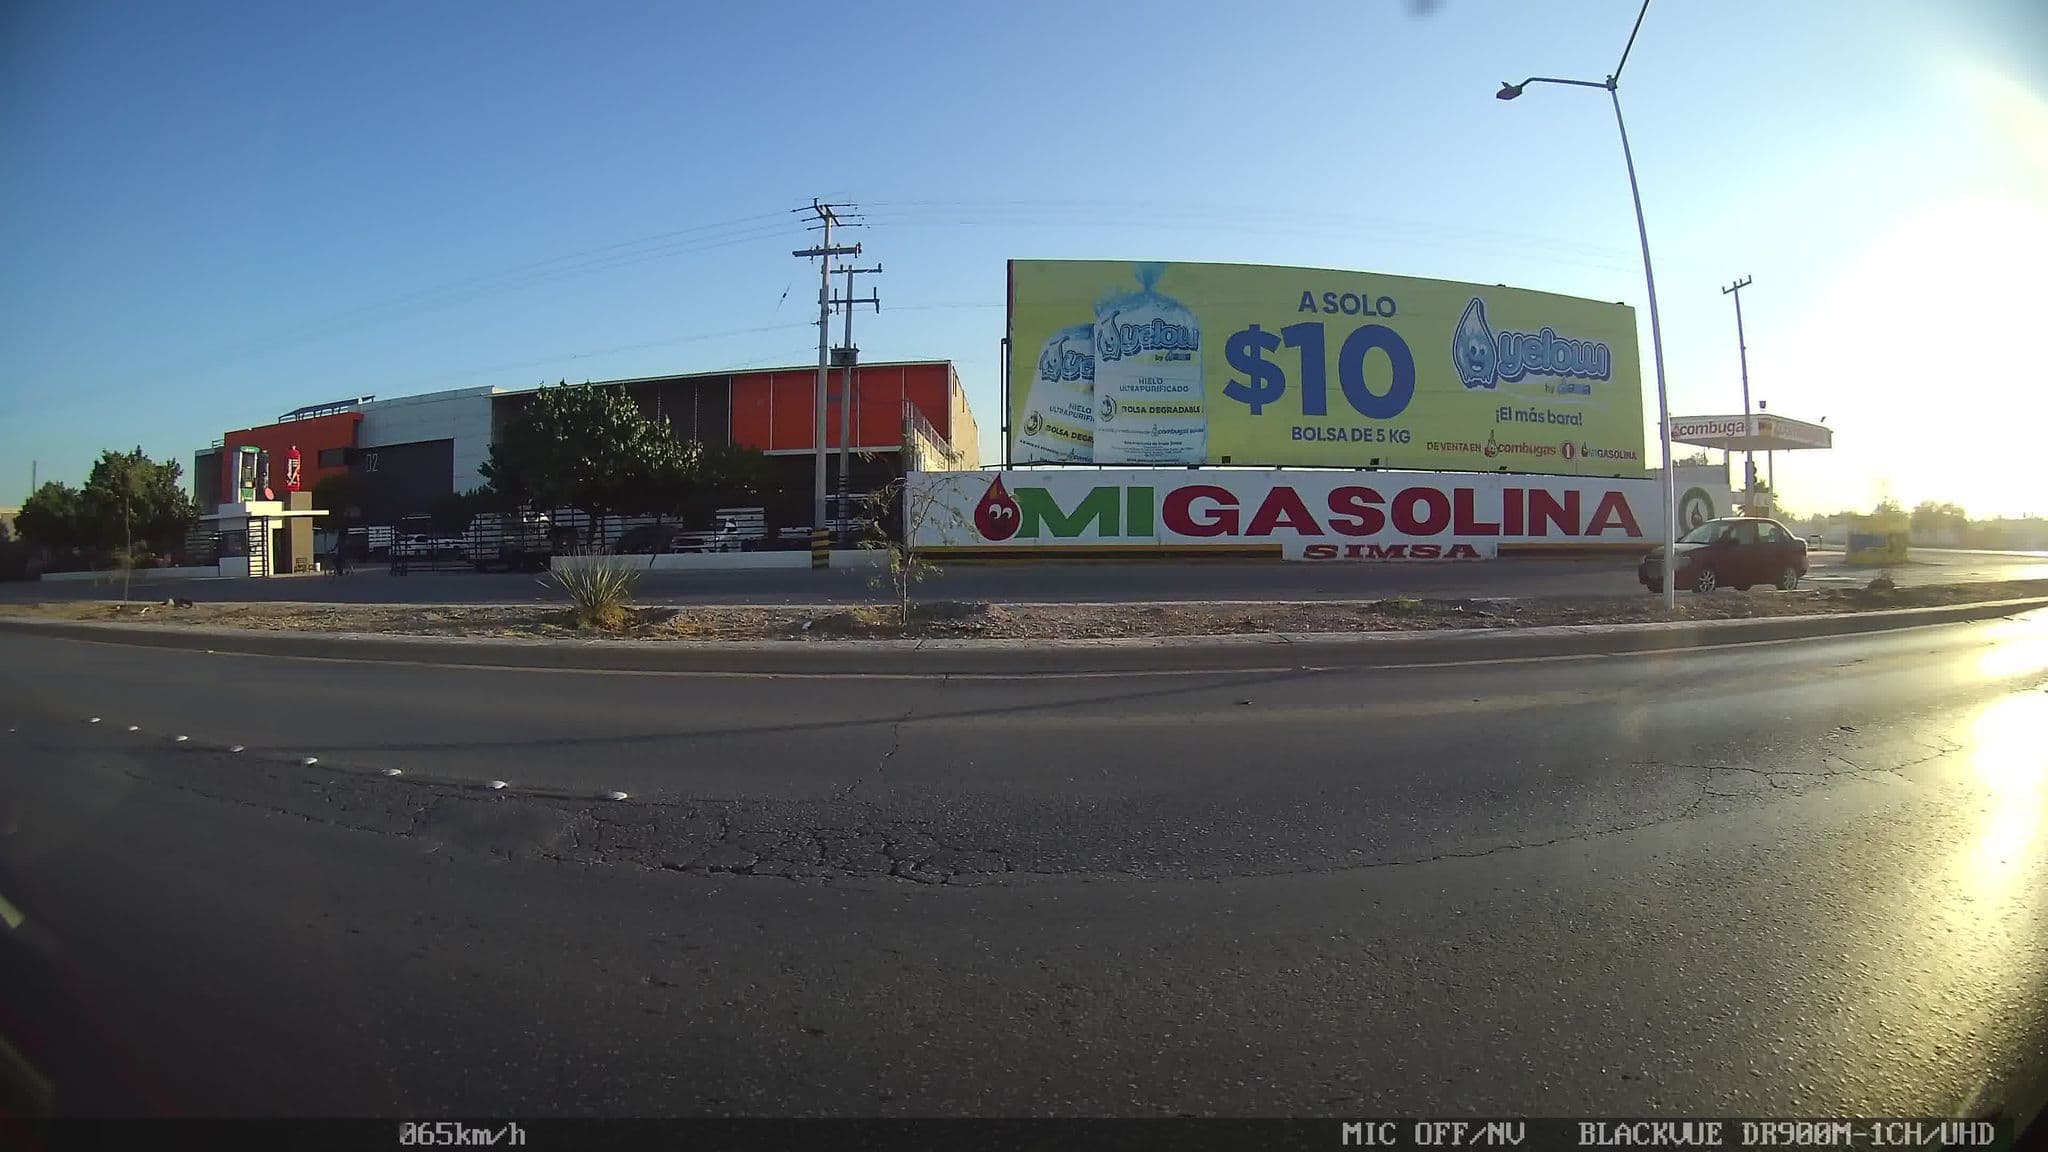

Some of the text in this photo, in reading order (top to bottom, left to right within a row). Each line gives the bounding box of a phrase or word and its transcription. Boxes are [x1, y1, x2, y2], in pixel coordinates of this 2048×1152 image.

[1299, 290, 1396, 318] A SOLO
[1498, 326, 1611, 382] yelow
[1223, 321, 1416, 420] $10
[1119, 385, 1189, 393] ULTRAPURIFICADO
[1138, 377, 1164, 385] HIELO
[1122, 405, 1148, 414] BOLSA
[1496, 406, 1583, 426] ¡El más bara!
[1291, 426, 1411, 444] BOLSA DE 5 KG
[1680, 420, 1747, 437] combuga
[1426, 441, 1439, 451] DE
[1440, 442, 1469, 452] VENTA
[1470, 443, 1482, 452] EN
[1498, 442, 1557, 457] combugas
[1303, 543, 1482, 560] SIMSA
